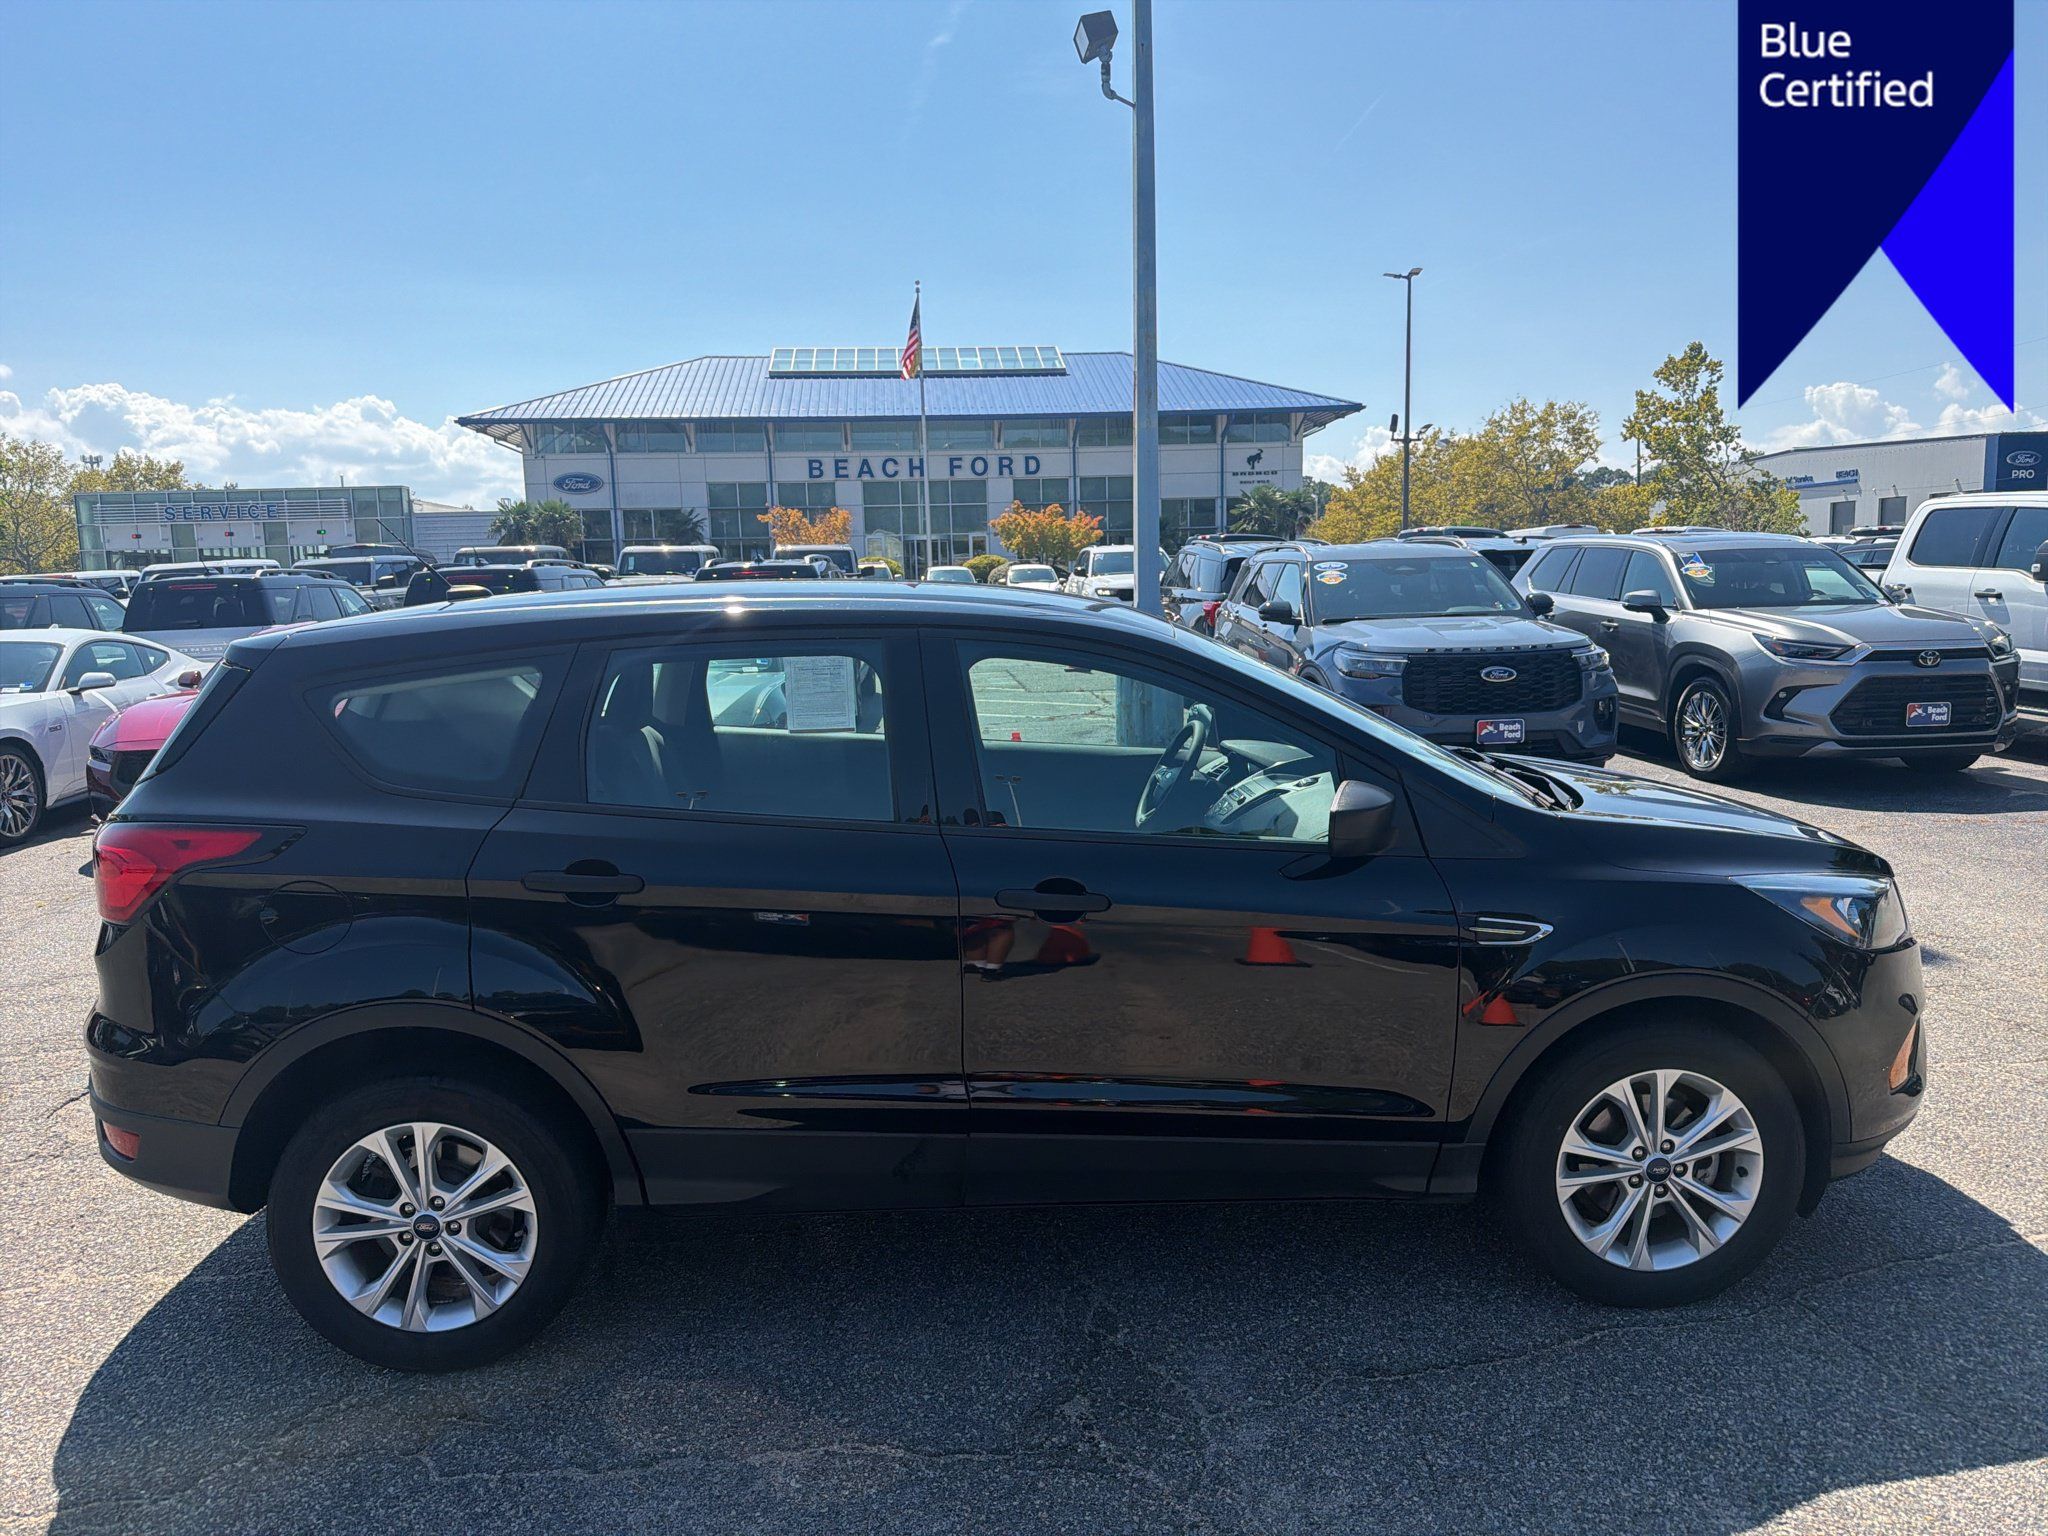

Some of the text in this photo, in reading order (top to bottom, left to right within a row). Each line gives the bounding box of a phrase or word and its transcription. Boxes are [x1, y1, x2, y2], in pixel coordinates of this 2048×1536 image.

[807, 455, 1042, 479] BEACH FORD
[2011, 469, 2036, 479] PRO
[164, 504, 280, 521] SERVICE
[1926, 705, 1948, 714] Beach
[1931, 713, 1948, 722] Ford
[1499, 722, 1521, 732] Beach
[1504, 731, 1521, 739] Ford
